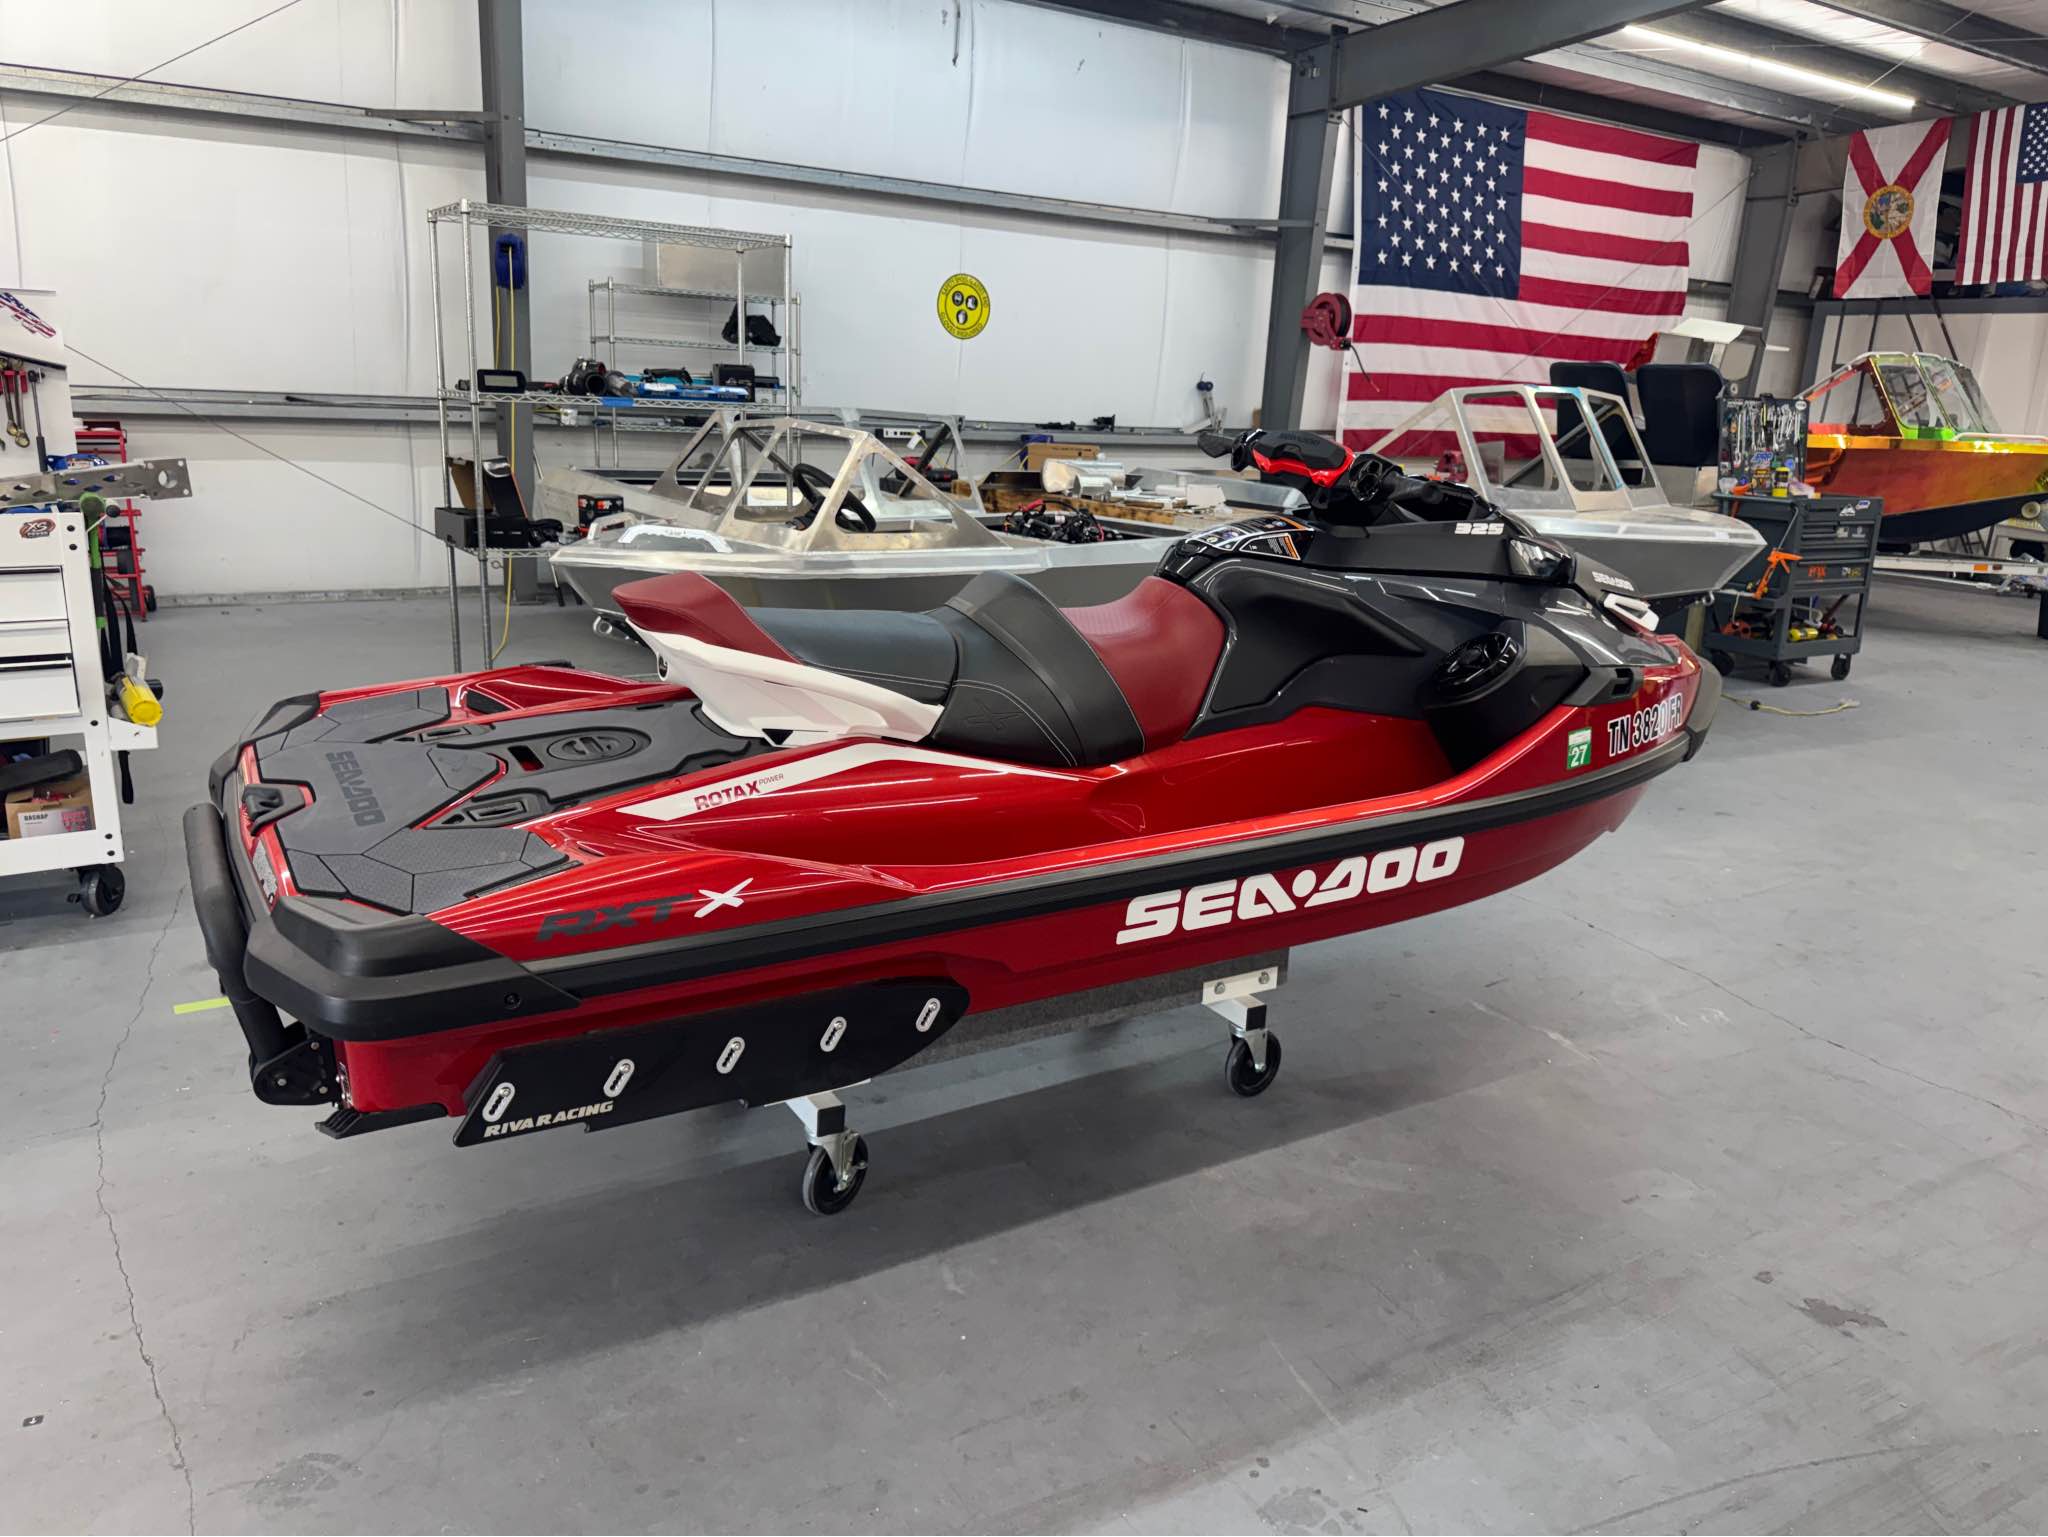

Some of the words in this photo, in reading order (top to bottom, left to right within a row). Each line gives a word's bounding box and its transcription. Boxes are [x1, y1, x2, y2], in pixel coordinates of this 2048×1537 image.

[26, 521, 49, 532] XS
[1454, 522, 1505, 535] 325
[1608, 714, 1631, 757] TN
[1632, 700, 1668, 747] 3820
[1570, 743, 1588, 768] 27
[693, 780, 760, 811] ROTAX
[758, 773, 784, 787] POWER
